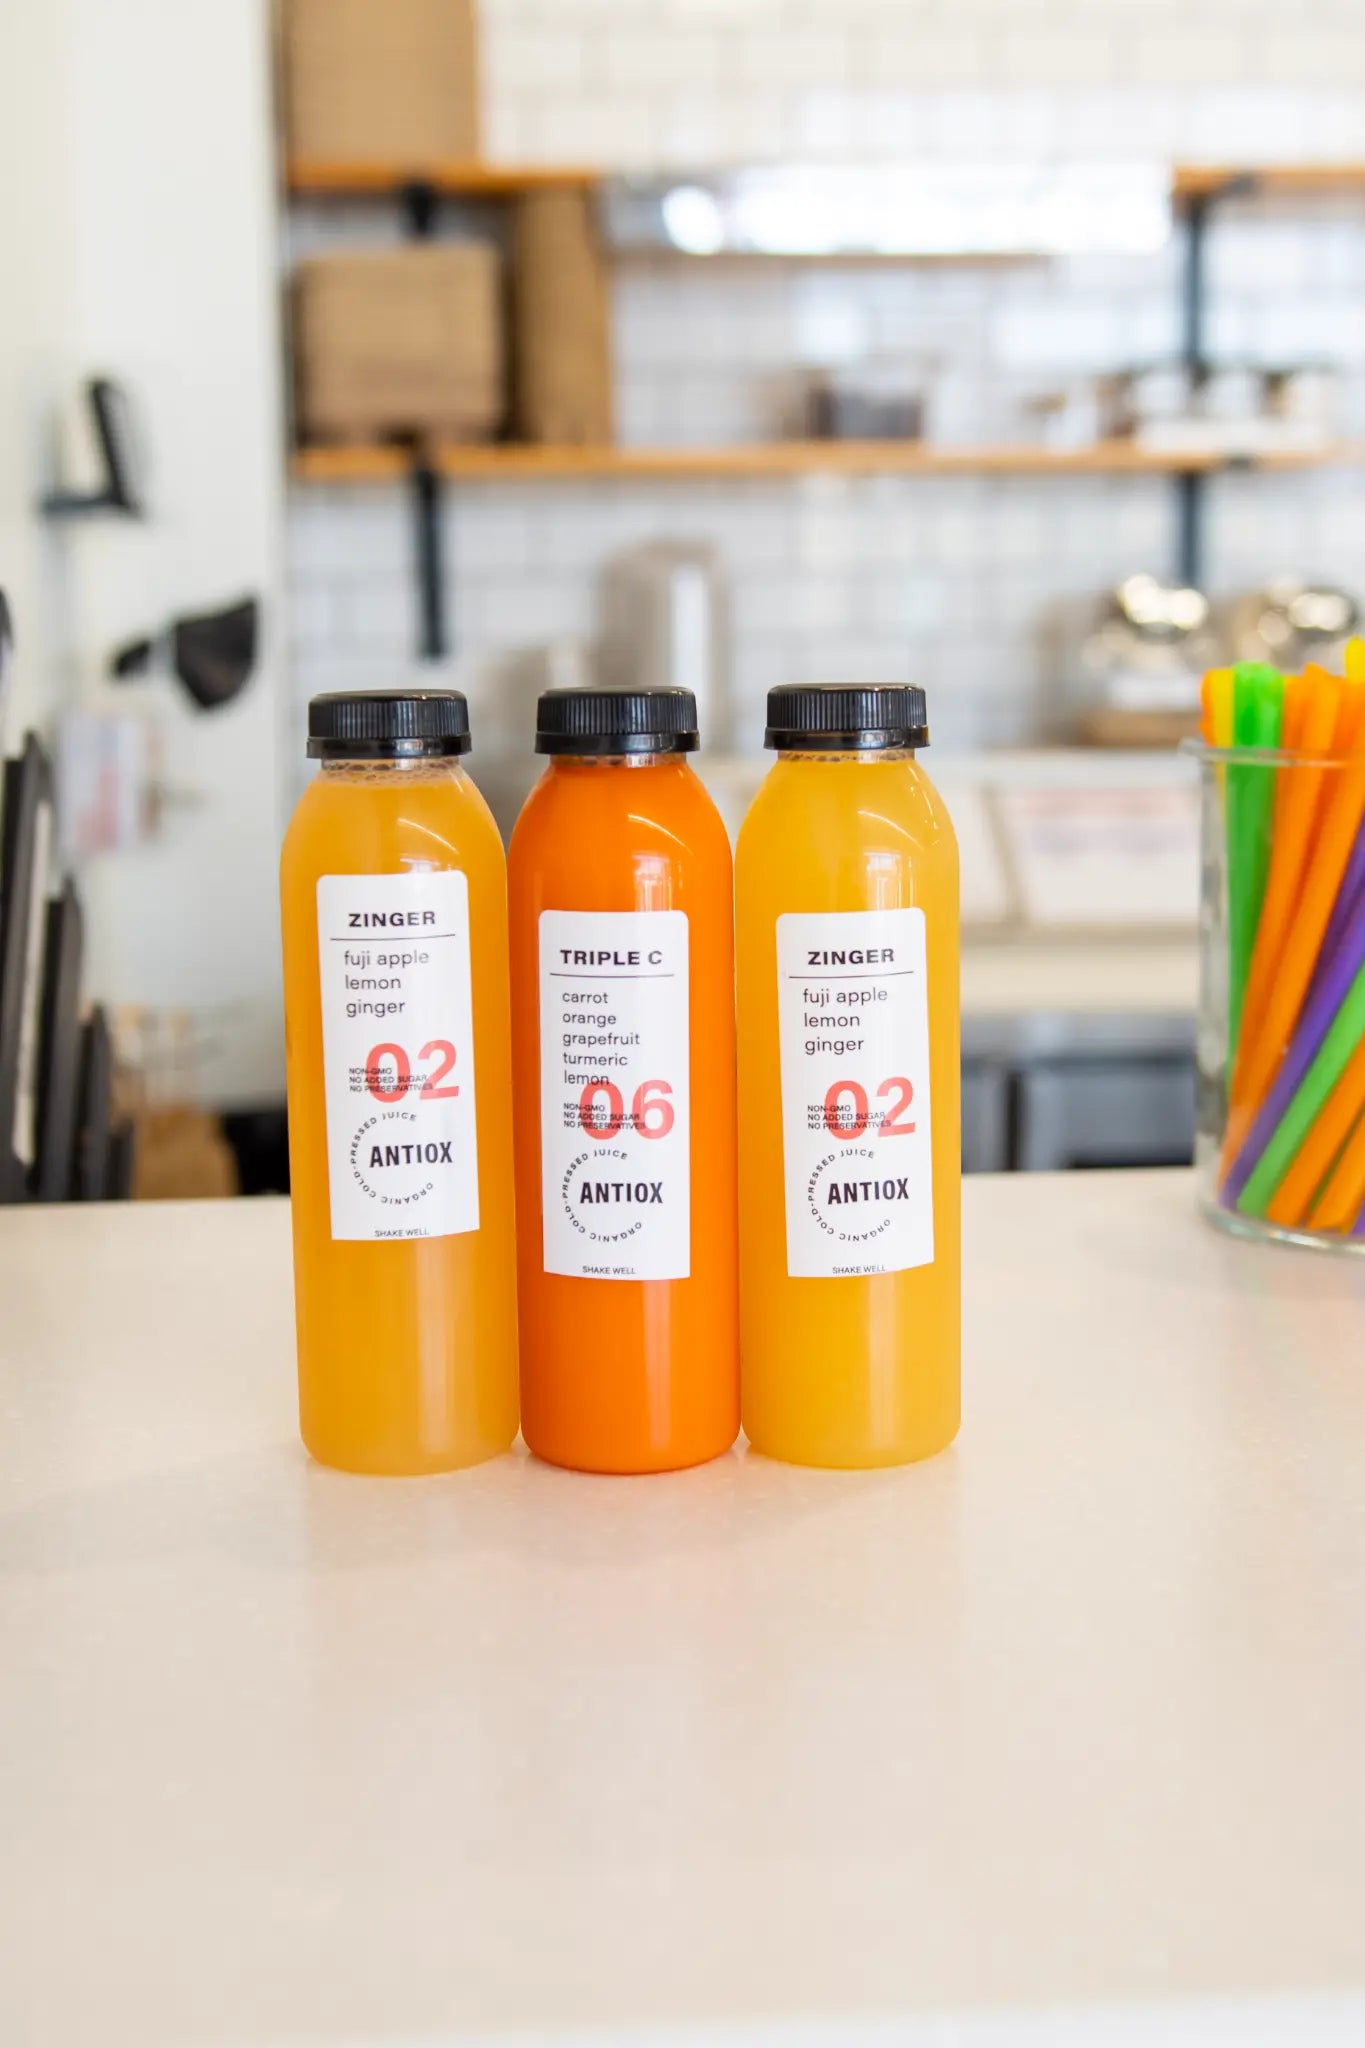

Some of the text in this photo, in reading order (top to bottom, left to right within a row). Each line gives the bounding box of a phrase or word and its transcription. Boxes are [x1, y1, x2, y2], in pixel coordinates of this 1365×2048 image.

[348, 911, 436, 927] ZINGER
[344, 950, 429, 969] fuji apple
[560, 950, 662, 965] TRIPLE C
[808, 949, 894, 965] ZINGER
[345, 975, 401, 990] lemon
[562, 992, 608, 1004] carrot
[803, 987, 888, 1007] fuji apple
[346, 999, 405, 1018] ginger
[562, 1013, 616, 1027] orange
[804, 1013, 860, 1027] lemon
[562, 1032, 640, 1047] grapefruit
[805, 1037, 864, 1055] ginger
[563, 1052, 628, 1066] turmeric
[349, 1067, 392, 1075] NON-GMO
[366, 1040, 459, 1103] 02
[564, 1070, 609, 1085] lemon
[398, 1075, 427, 1083] SUGAR
[365, 1084, 433, 1092] PRESERVATIVES
[563, 1103, 605, 1112] NON-GMO
[579, 1080, 674, 1140] 06
[824, 1077, 916, 1140] 02
[382, 1111, 416, 1121] JUICE
[578, 1113, 607, 1121] ADDED
[823, 1113, 853, 1121] ADDED
[856, 1112, 885, 1120] SUGAR
[578, 1121, 646, 1129] PRESERVATIVES
[823, 1121, 891, 1130] PRESERVATIVES
[370, 1141, 453, 1168] ANTIOX
[594, 1149, 628, 1160] JUICE
[841, 1149, 875, 1159] JUICE
[382, 1182, 433, 1205] ORGANIC
[580, 1182, 663, 1204] ANTIOX
[827, 1178, 909, 1205] ANTIOX
[374, 1228, 429, 1237] SHAKE WELL
[590, 1222, 642, 1243] ORGANIC
[839, 1219, 890, 1242] ORGANIC
[583, 1266, 636, 1275] SHAKE WELL
[832, 1265, 886, 1275] SHAKE WELL
